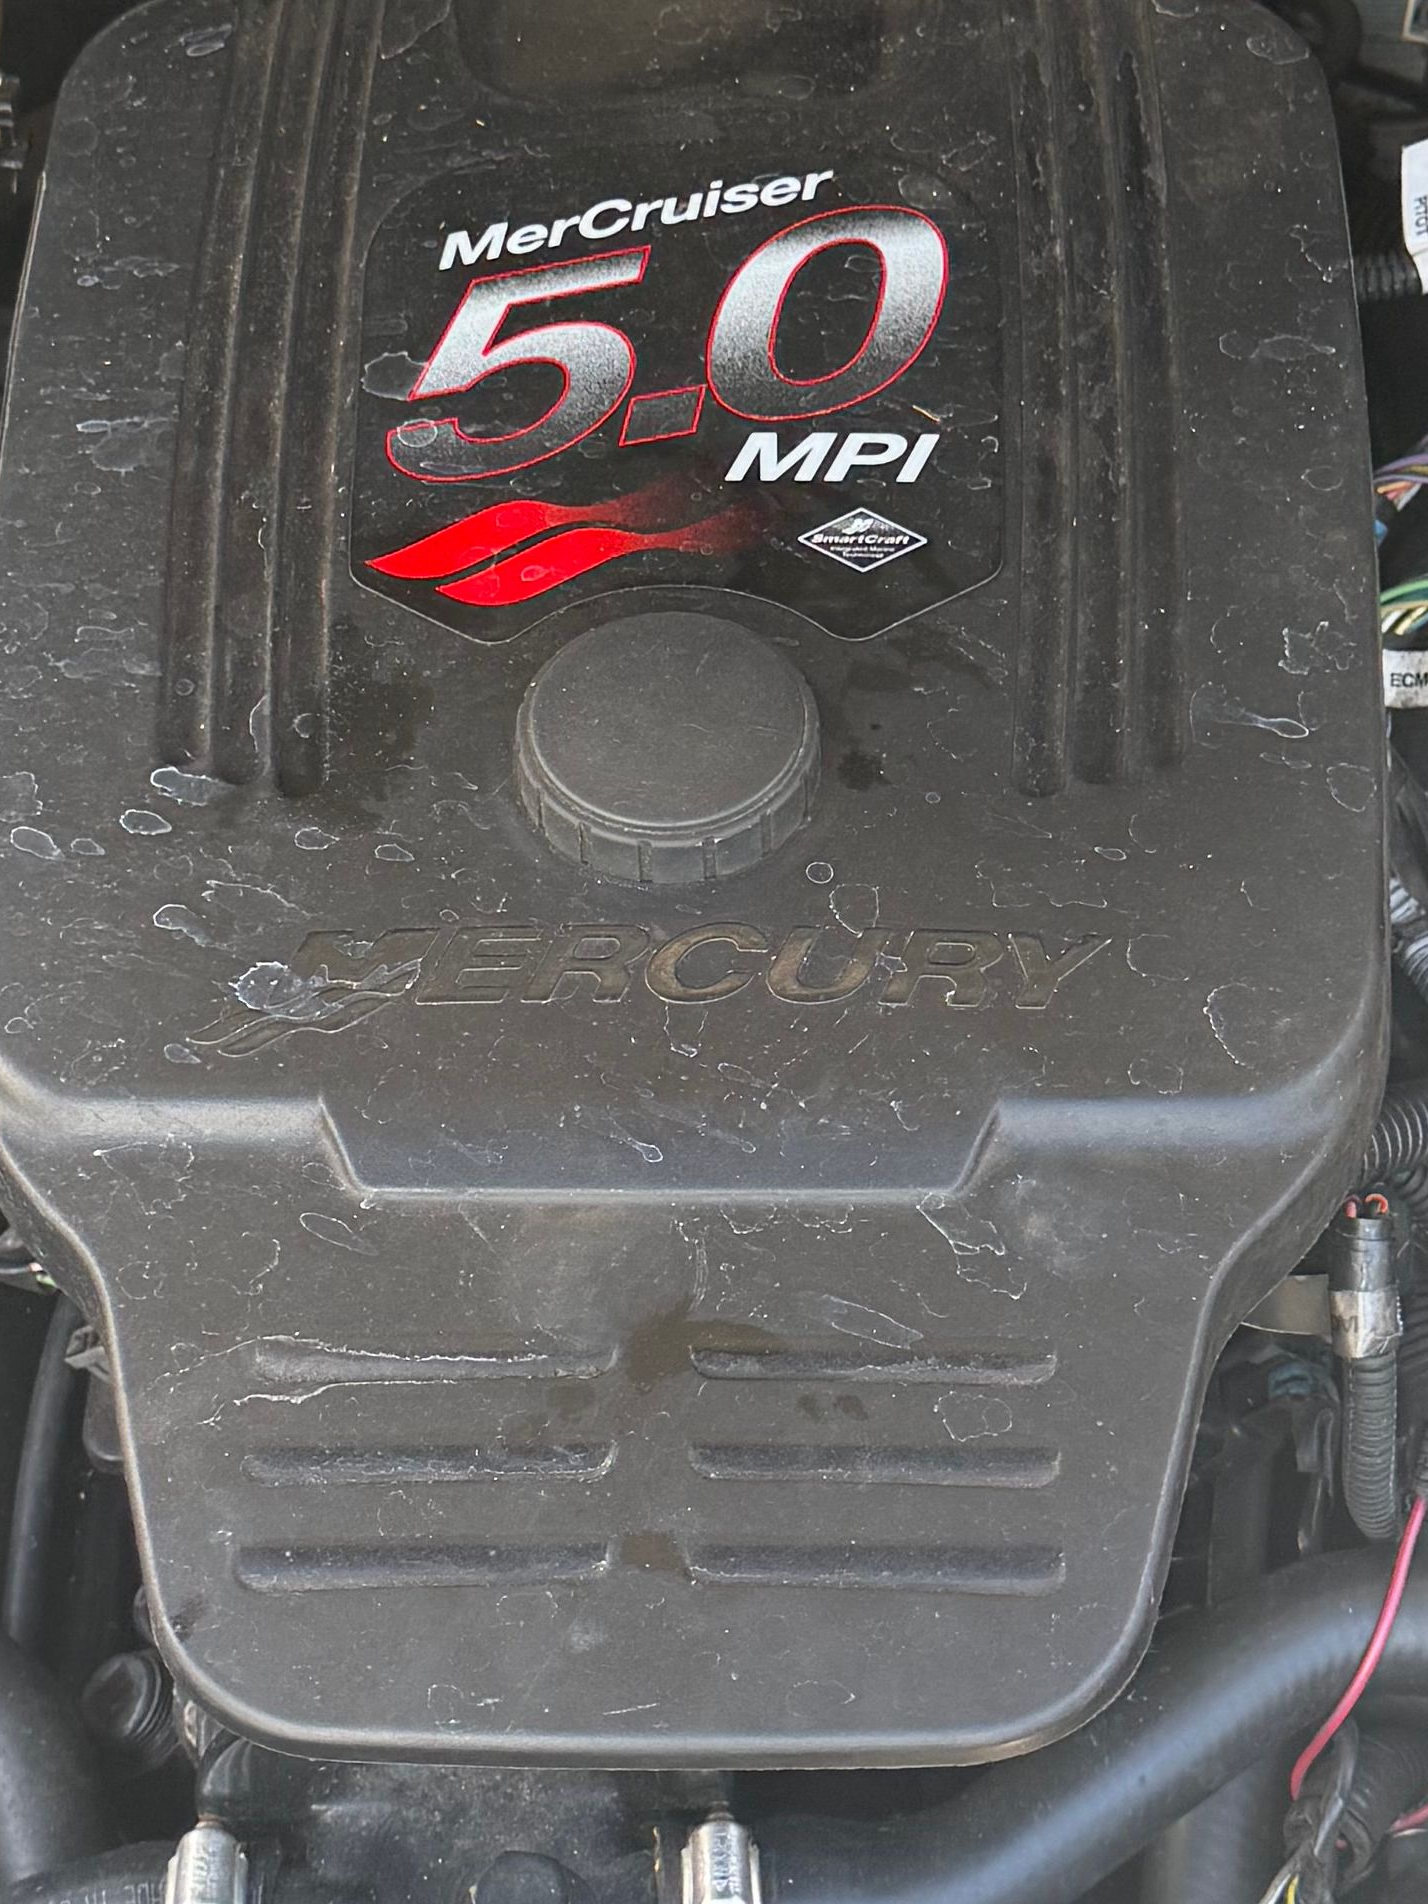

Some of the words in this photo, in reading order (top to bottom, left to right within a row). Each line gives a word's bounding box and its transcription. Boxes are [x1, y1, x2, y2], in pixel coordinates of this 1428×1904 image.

[438, 170, 835, 271] MerCruiser
[383, 203, 950, 484] 5.0
[724, 430, 943, 484] MPI
[810, 533, 911, 545] SmartCraft
[252, 919, 1113, 1016] MERCURY
